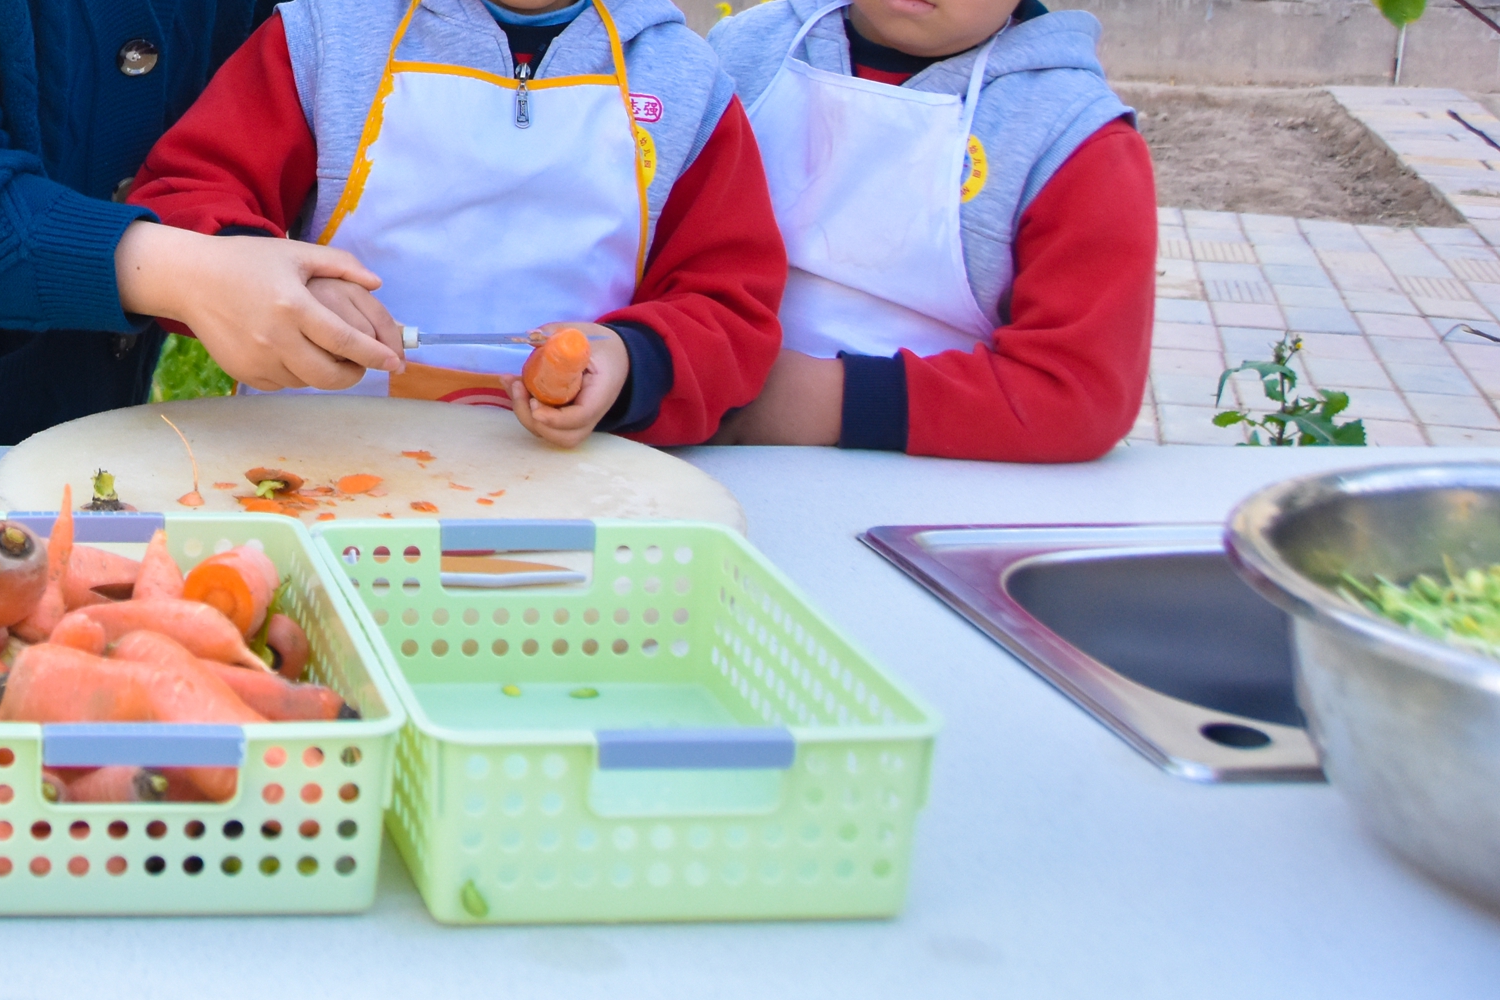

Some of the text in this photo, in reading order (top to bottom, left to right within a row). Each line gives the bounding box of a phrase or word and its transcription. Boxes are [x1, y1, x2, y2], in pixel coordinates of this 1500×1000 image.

[637, 132, 652, 169] 幼儿园
[967, 138, 982, 179] 幼儿园
